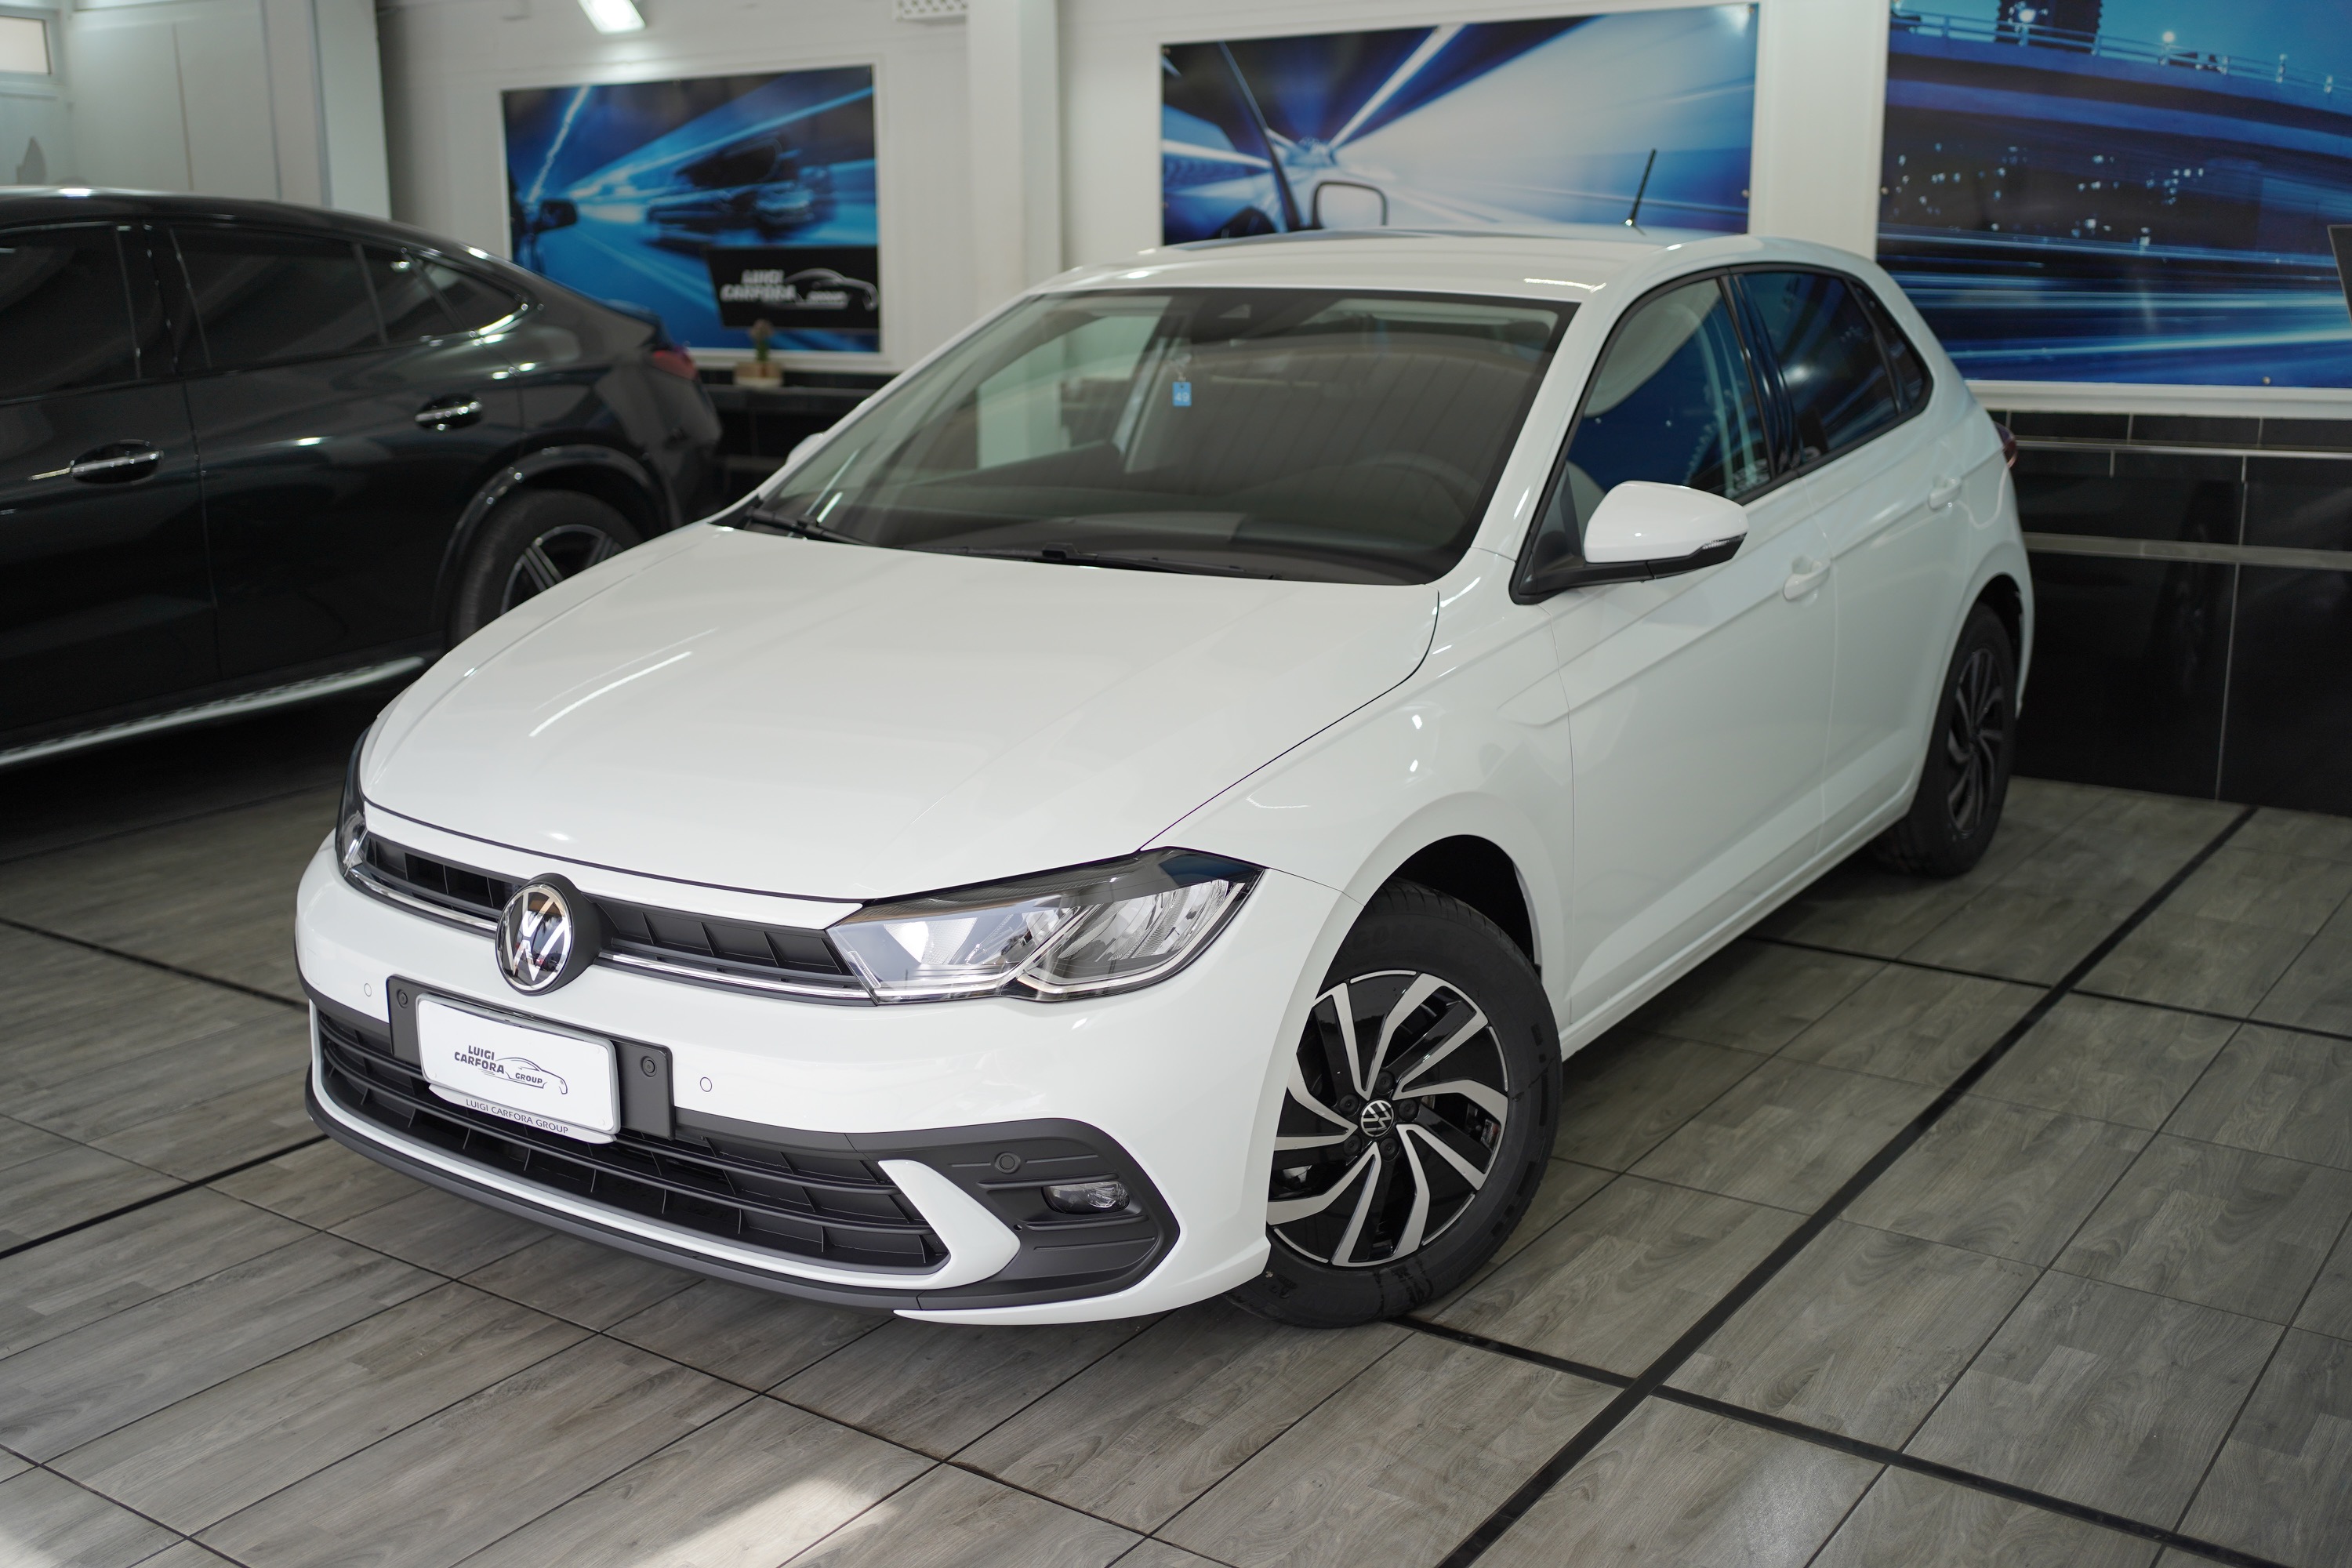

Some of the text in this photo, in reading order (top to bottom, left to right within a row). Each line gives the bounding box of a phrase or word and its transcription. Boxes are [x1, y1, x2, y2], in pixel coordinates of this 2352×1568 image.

[454, 1051, 505, 1074] CARFORA
[468, 1045, 495, 1061] LUIGI
[515, 1073, 543, 1084] GROUP
[466, 1099, 568, 1134] LUIGI CARFORA GROUP
